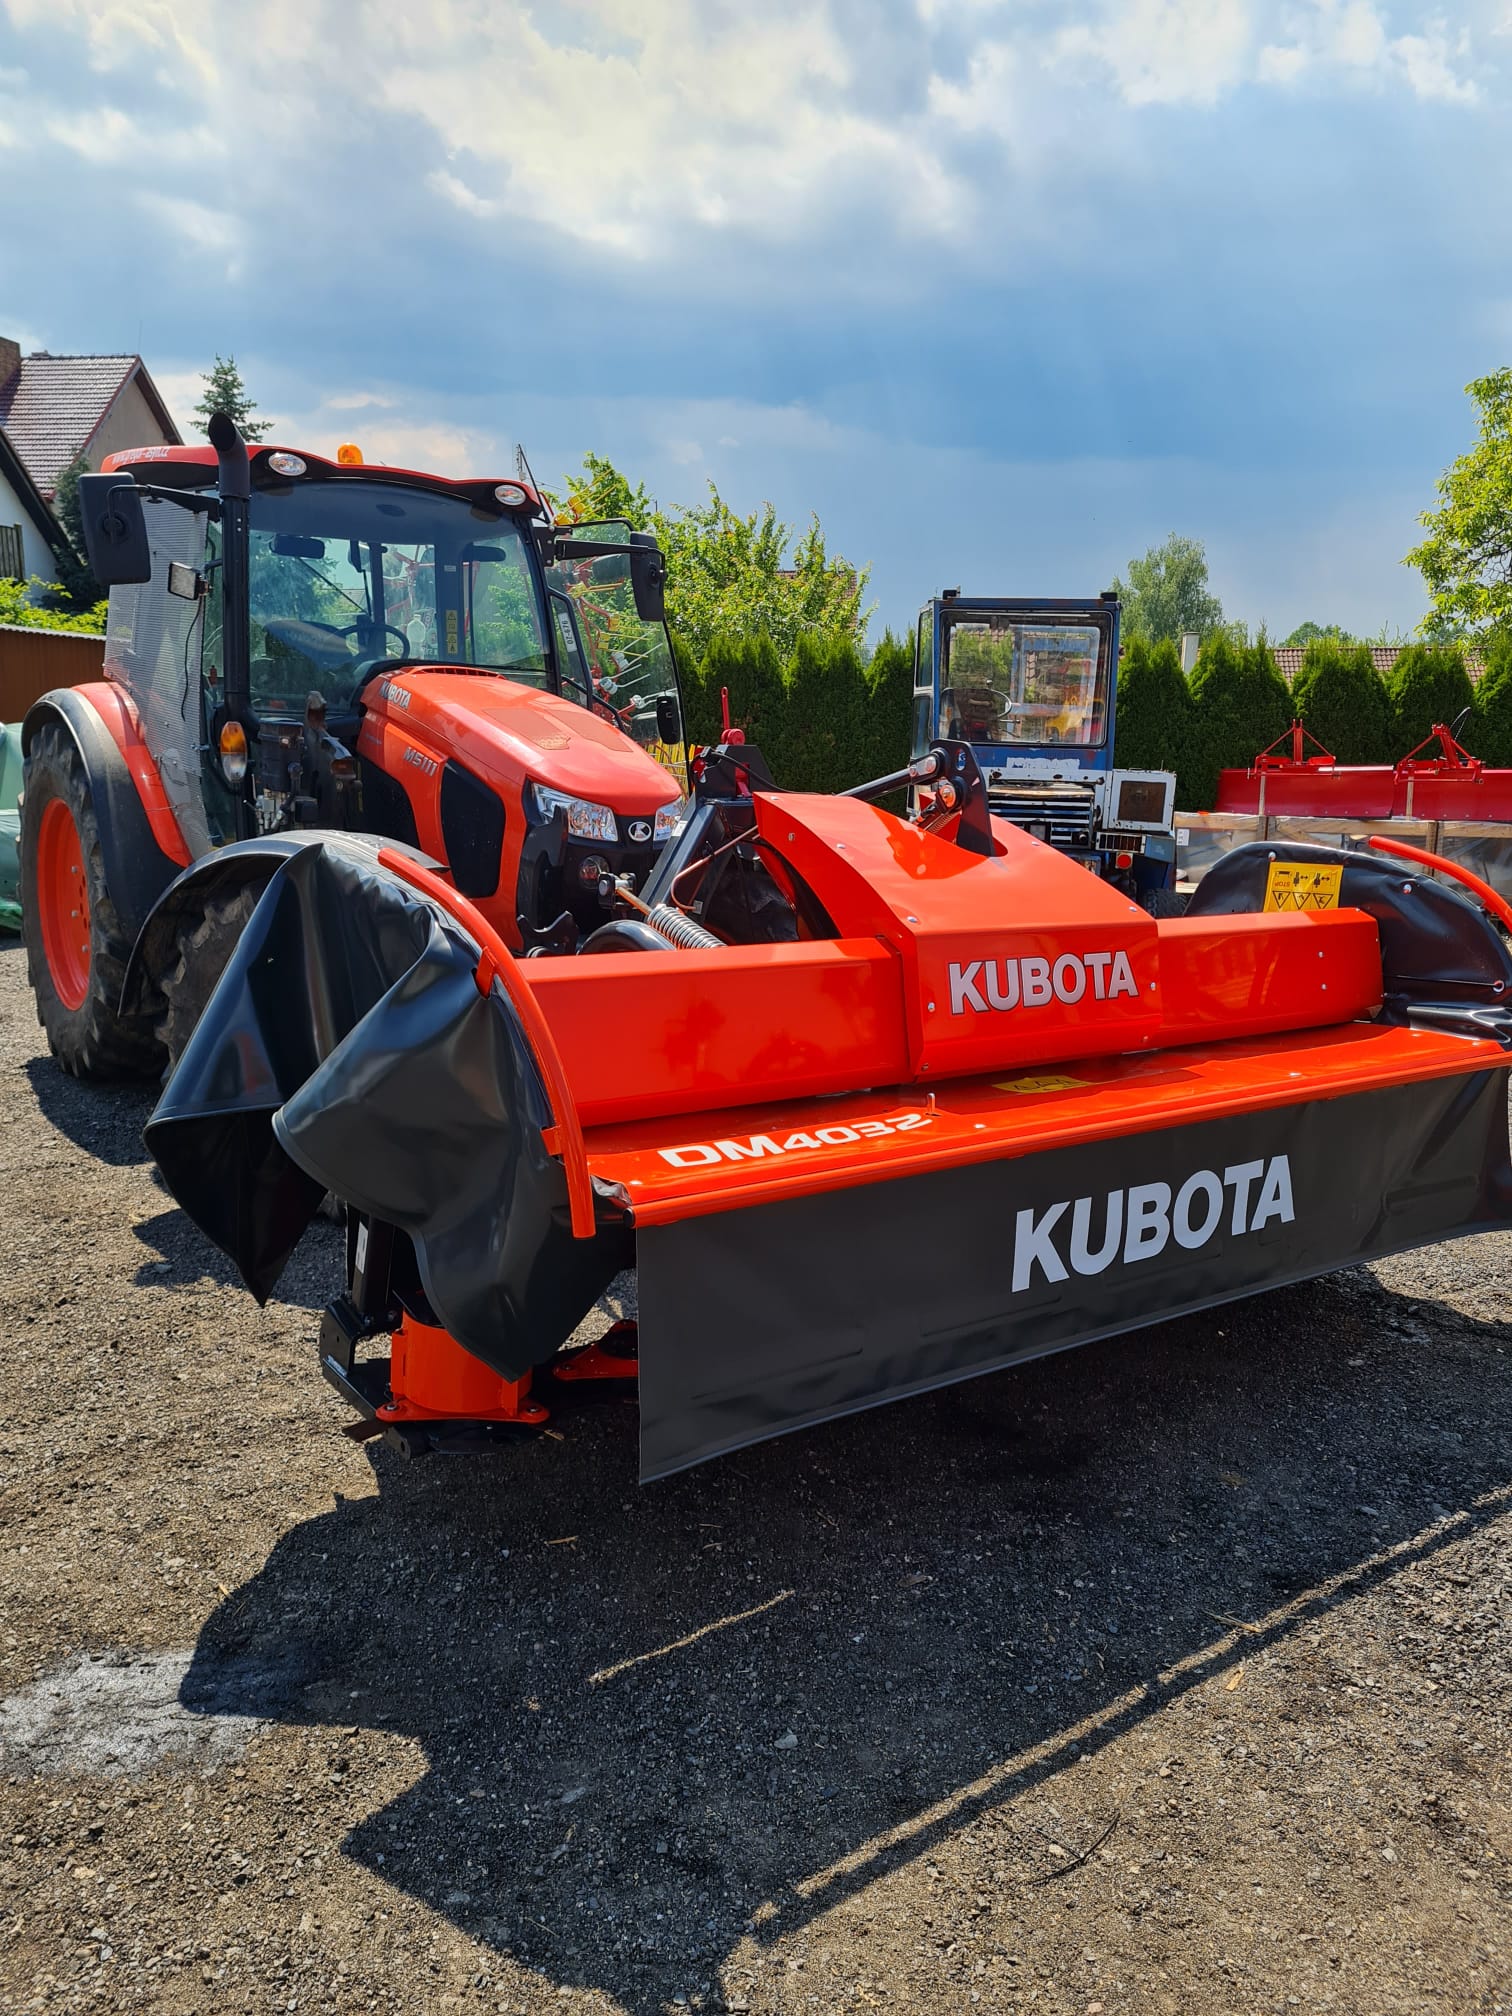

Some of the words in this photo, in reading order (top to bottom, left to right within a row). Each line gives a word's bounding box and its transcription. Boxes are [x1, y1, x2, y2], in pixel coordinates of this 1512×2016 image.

[379, 680, 412, 710] KUBOTA
[403, 746, 438, 777] M5111
[949, 951, 1139, 1015] KUBOTA
[657, 1113, 933, 1168] DM4032
[1011, 1154, 1295, 1293] KUBOTA
